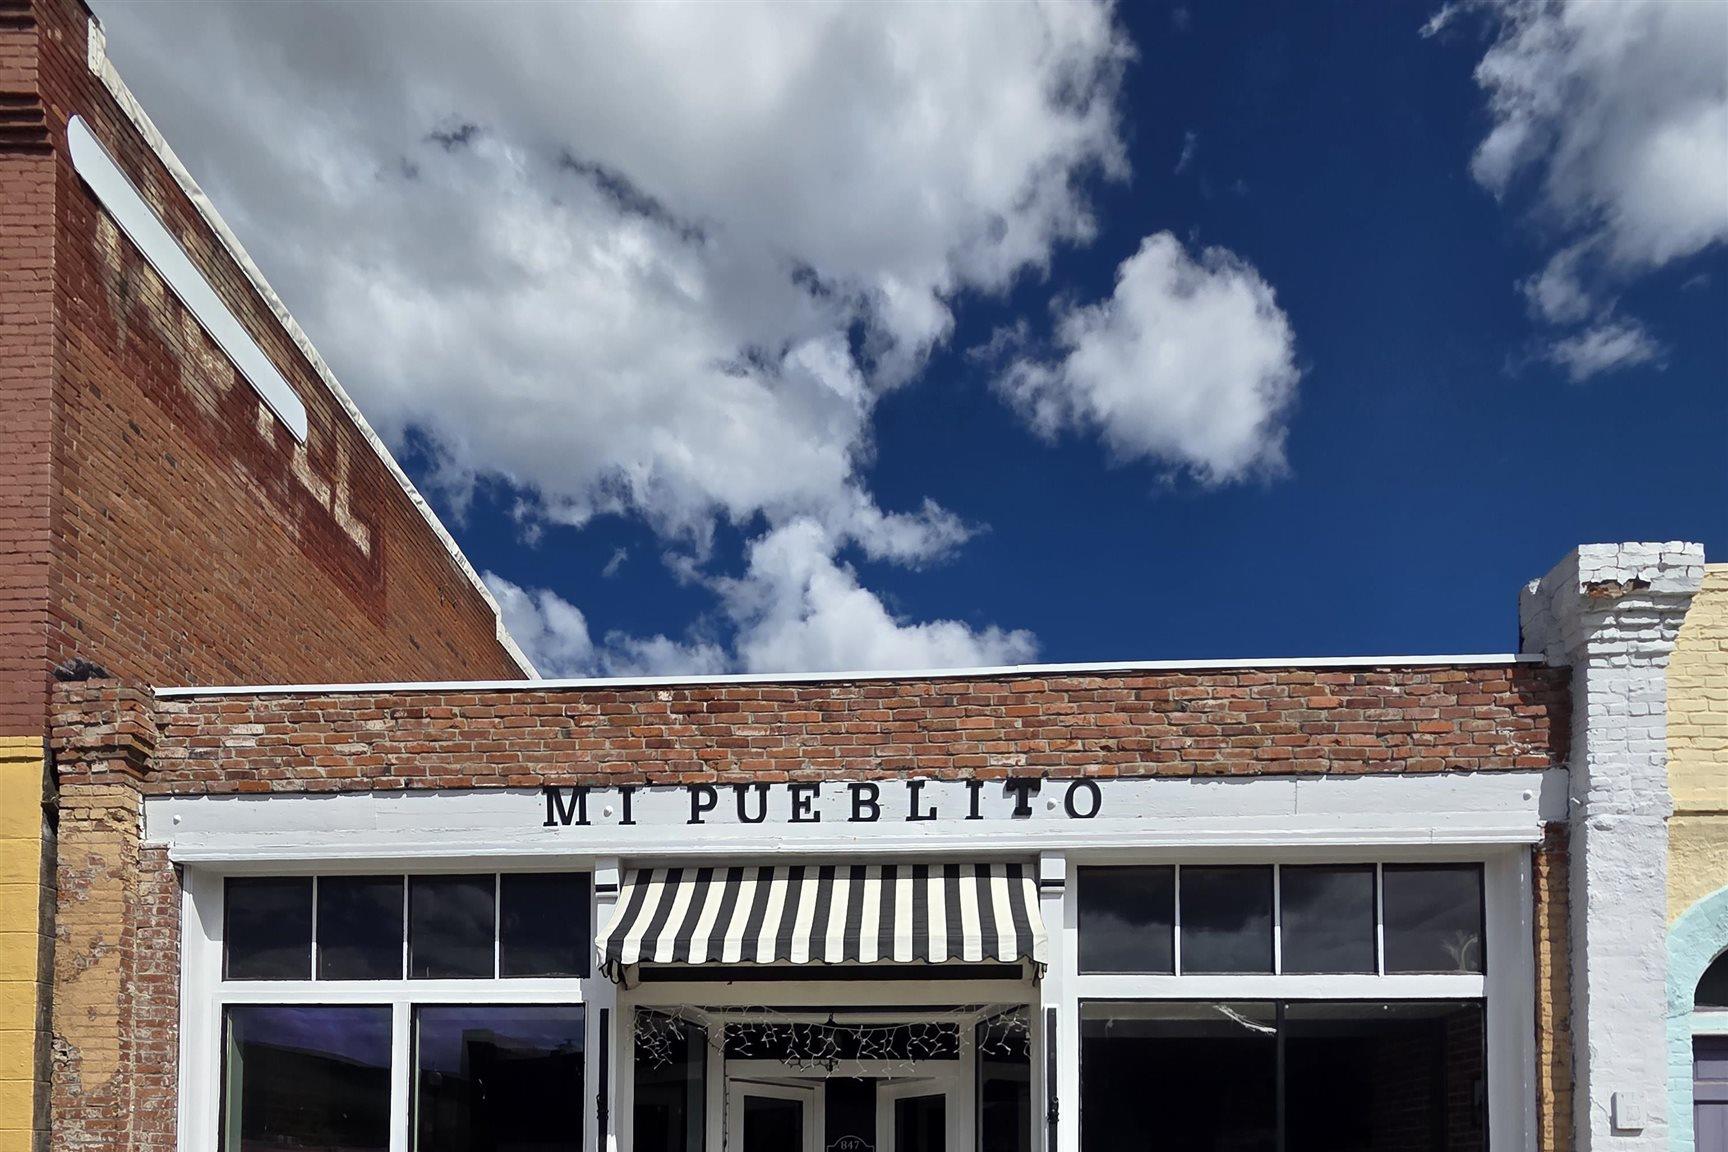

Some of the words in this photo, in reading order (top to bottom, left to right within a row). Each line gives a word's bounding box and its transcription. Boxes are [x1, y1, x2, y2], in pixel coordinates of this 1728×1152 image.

[543, 785, 636, 826] MI
[686, 778, 1102, 824] PUEBLITO
[840, 1140, 860, 1150] 847
